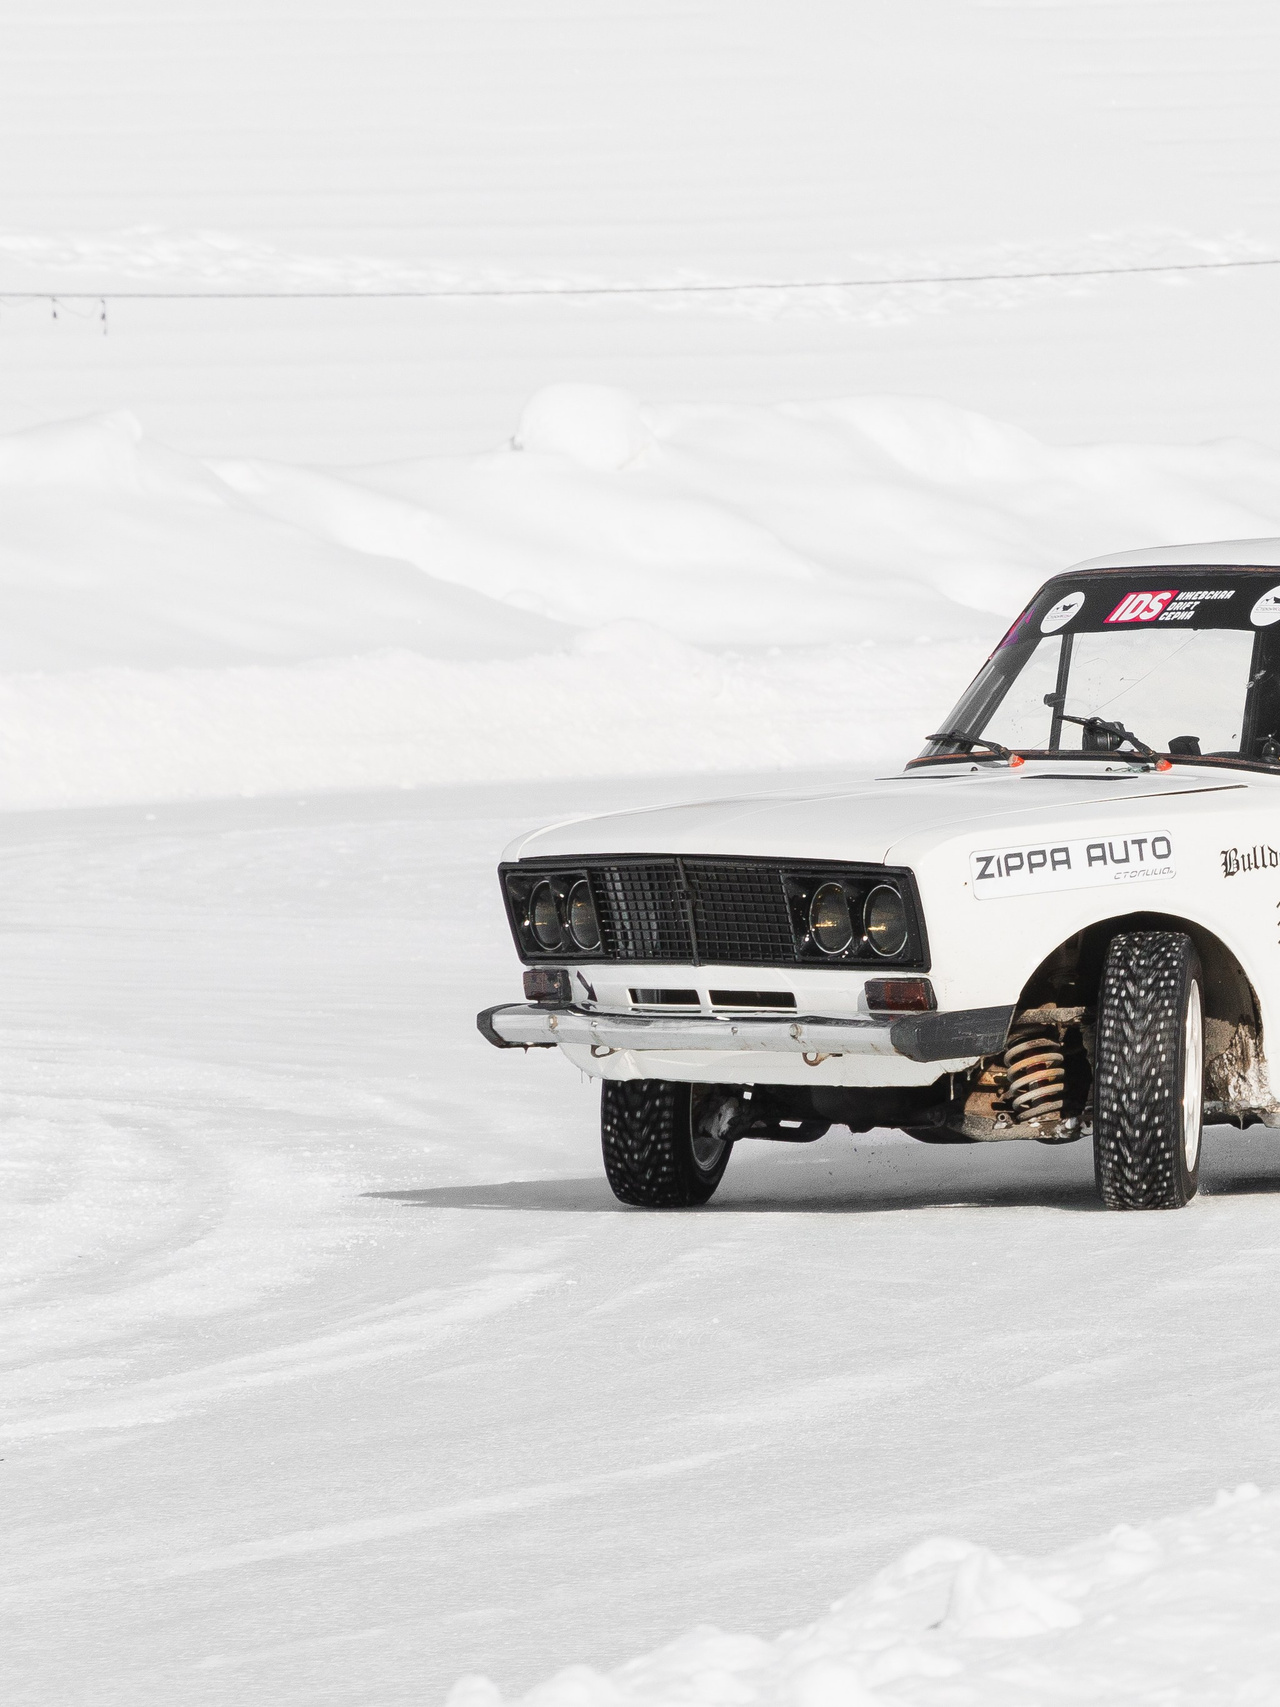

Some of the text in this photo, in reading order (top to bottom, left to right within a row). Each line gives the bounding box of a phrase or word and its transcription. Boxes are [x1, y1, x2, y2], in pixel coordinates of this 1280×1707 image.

[1175, 590, 1236, 601] ИЖЕВСКАЯ
[1108, 592, 1172, 622] IDS
[1166, 601, 1201, 611] DRIFT
[1158, 610, 1195, 621] СЕРИЯ
[975, 836, 1172, 881] ZIPPA AUTO
